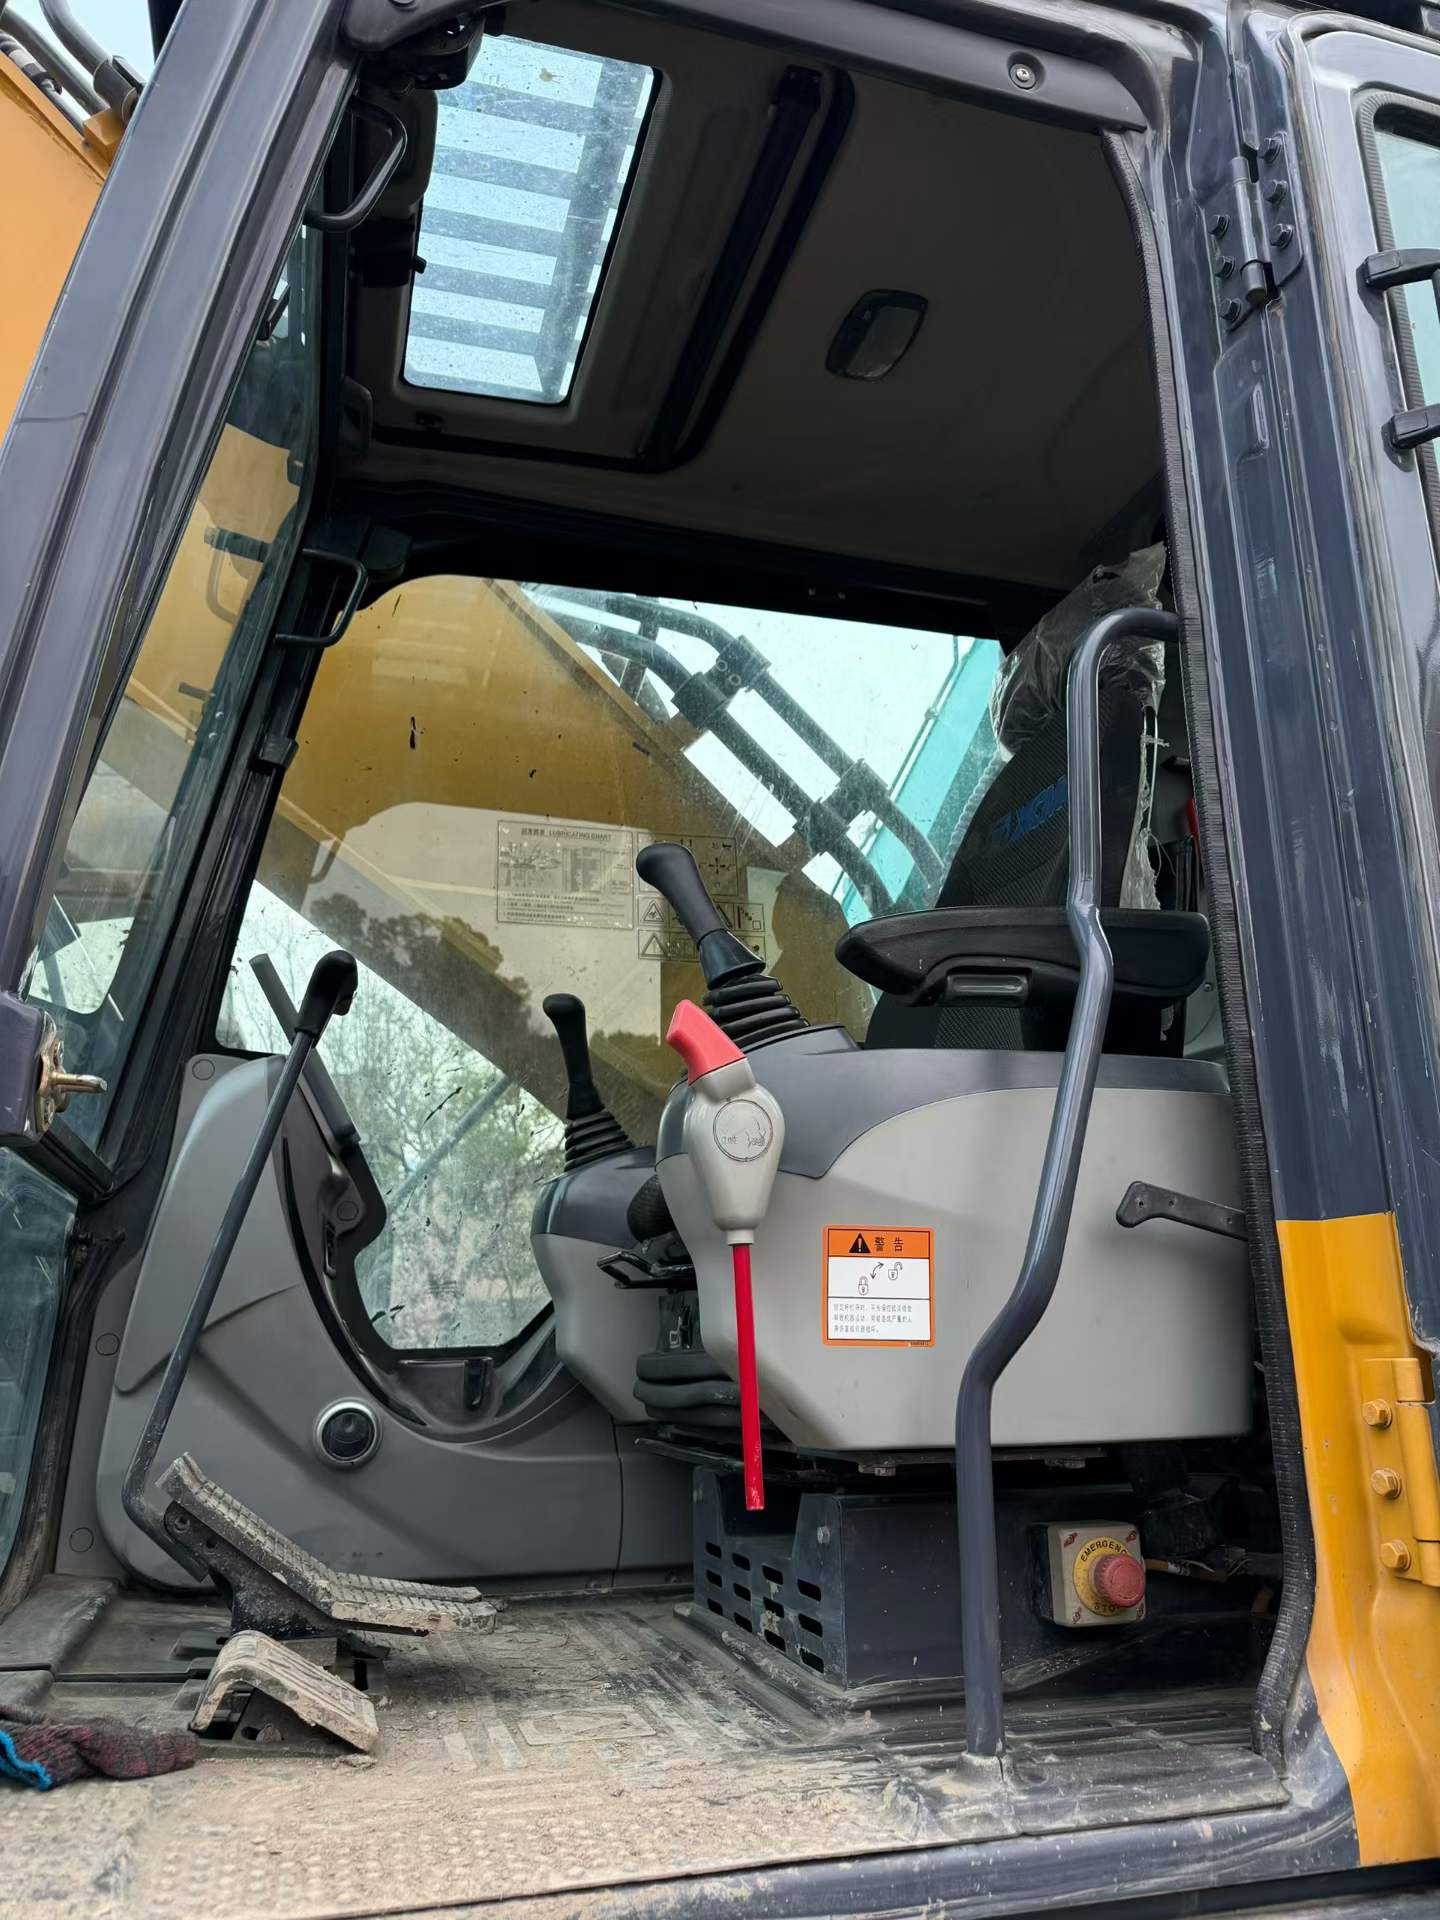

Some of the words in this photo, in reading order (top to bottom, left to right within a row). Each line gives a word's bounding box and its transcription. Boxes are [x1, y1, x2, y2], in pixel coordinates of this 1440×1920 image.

[874, 1236, 905, 1253] 警告
[1080, 1539, 1128, 1562] EMERGENC
[1094, 1602, 1122, 1612] STO
